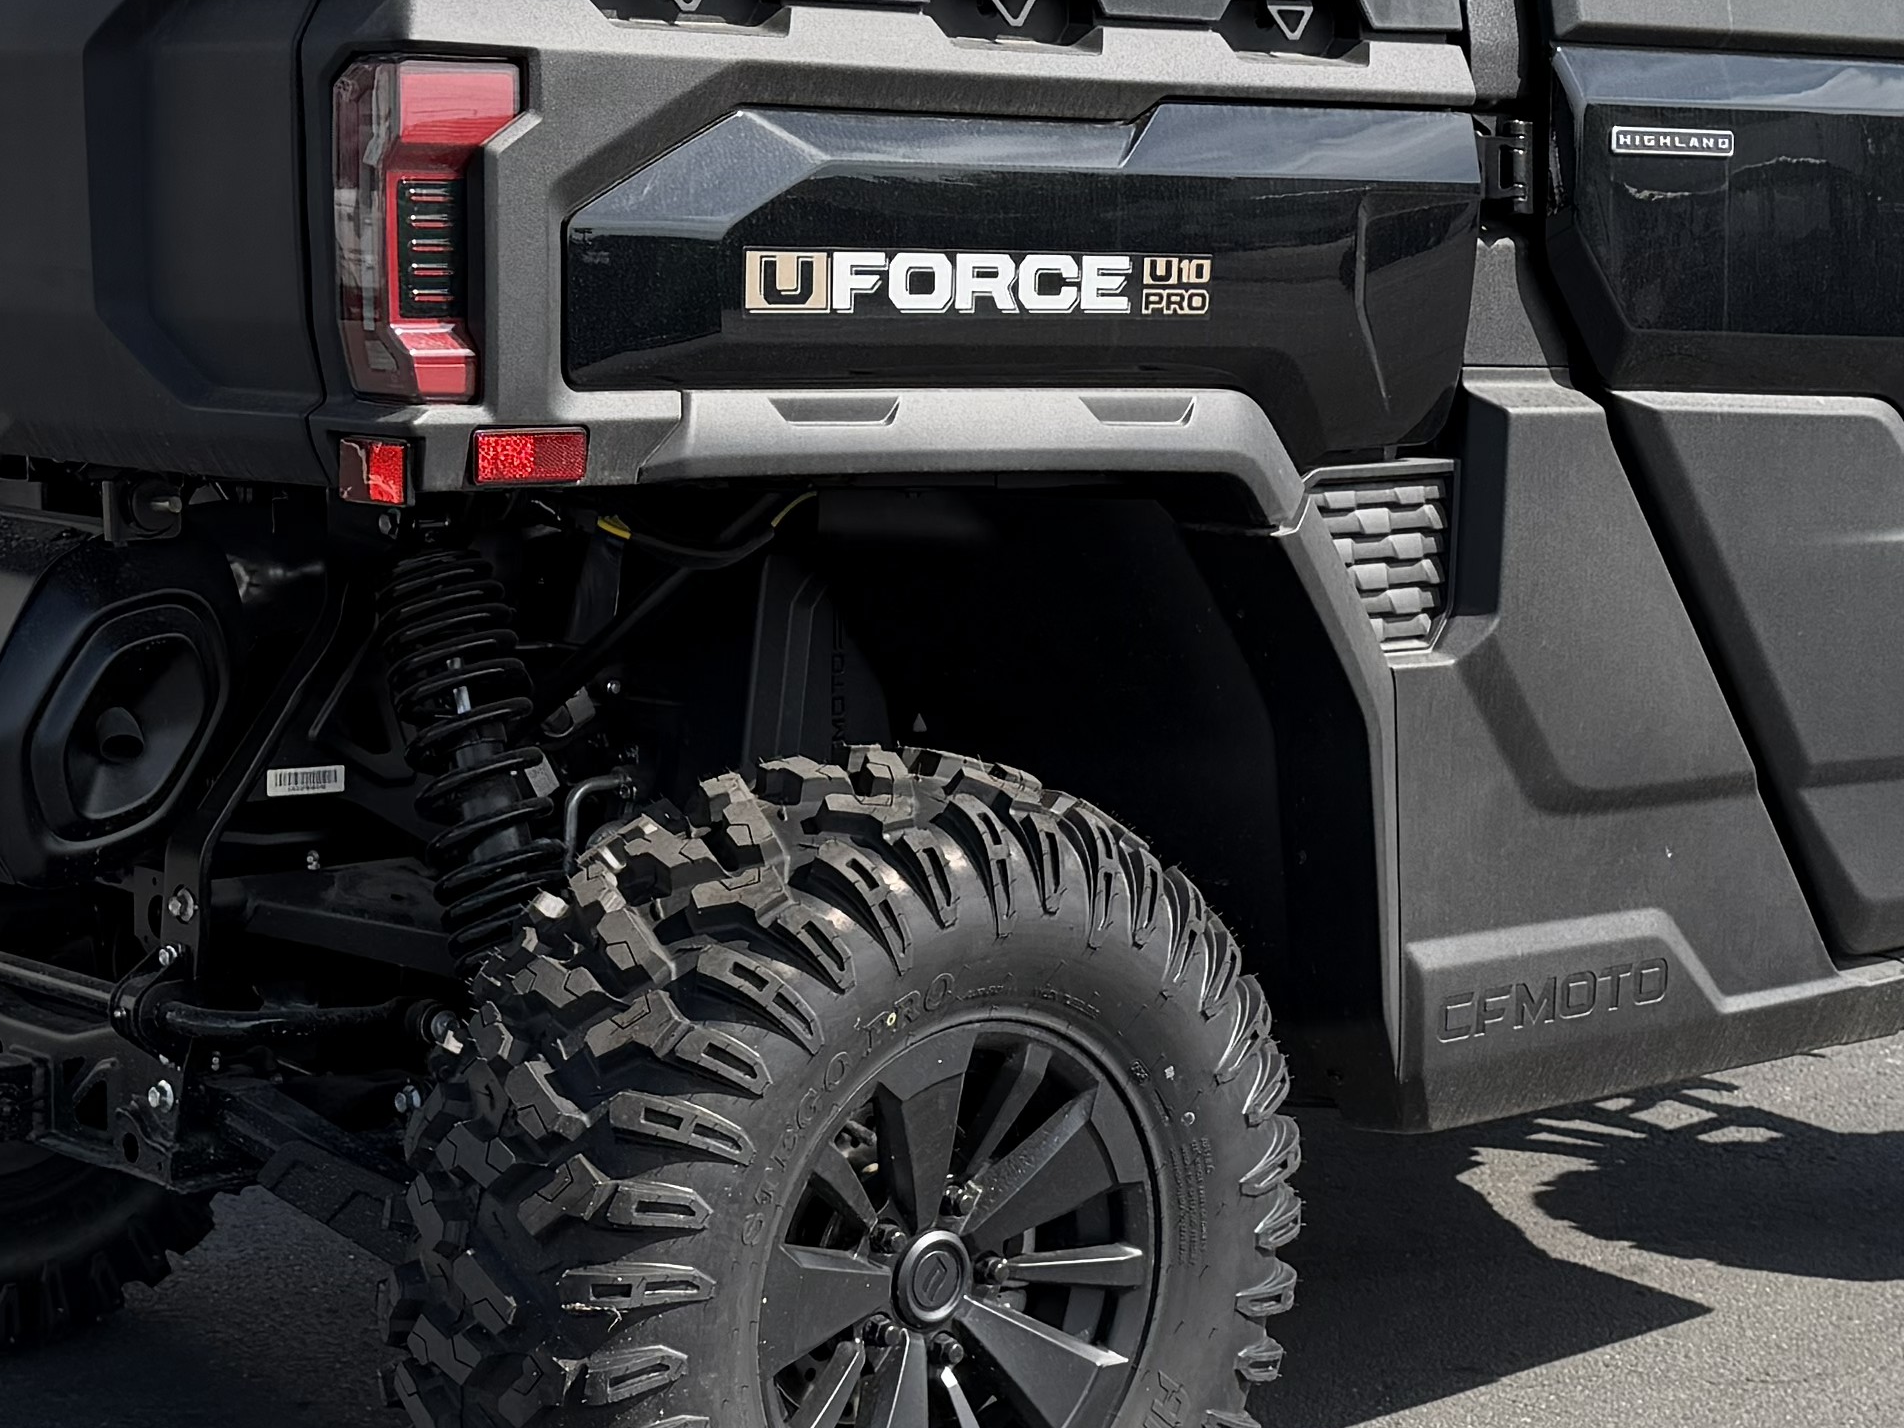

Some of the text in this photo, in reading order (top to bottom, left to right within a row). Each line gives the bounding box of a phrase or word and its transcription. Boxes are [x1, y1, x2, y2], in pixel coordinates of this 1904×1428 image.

[1618, 133, 1730, 149] HIGHLAND
[1143, 256, 1211, 285] U10
[1142, 289, 1210, 314] PRO
[1436, 956, 1669, 1043] CFMOTO
